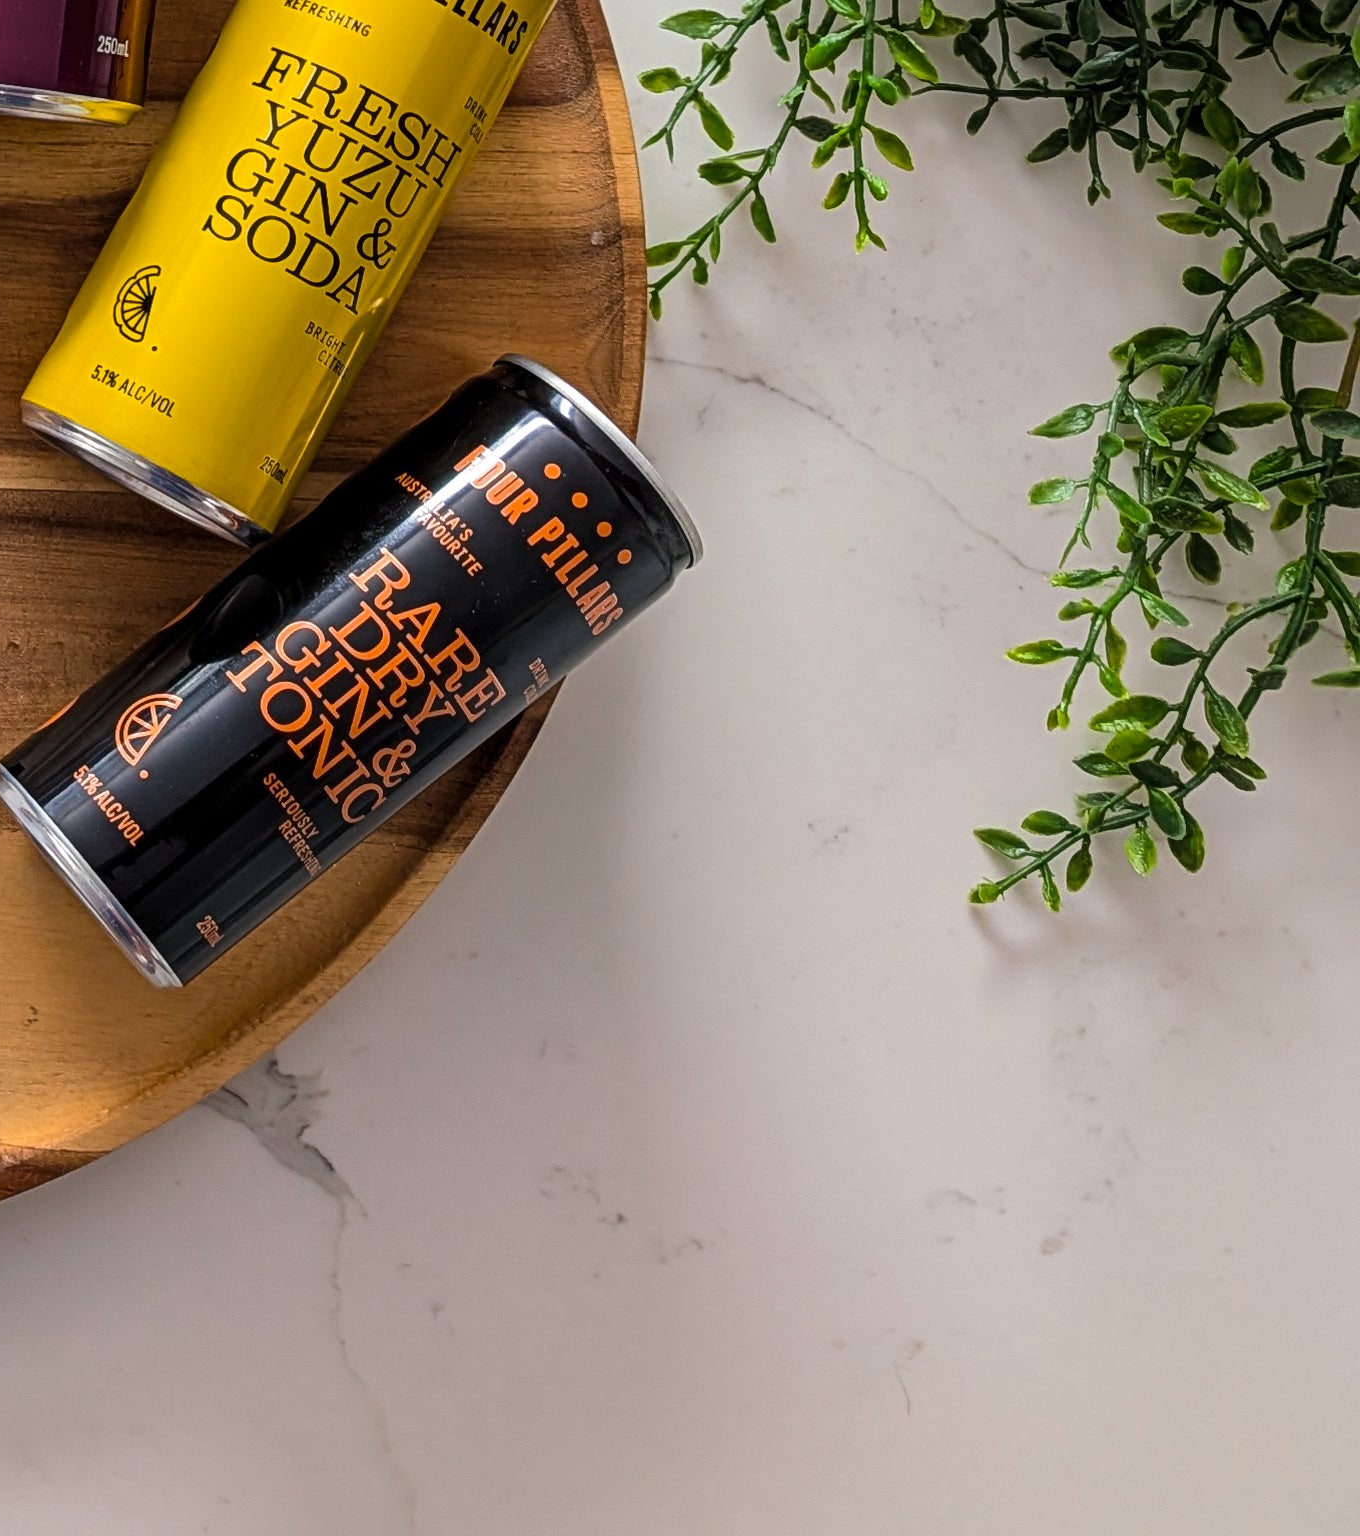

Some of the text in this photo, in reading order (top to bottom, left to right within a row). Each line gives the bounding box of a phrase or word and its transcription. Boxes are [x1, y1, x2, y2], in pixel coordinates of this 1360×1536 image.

[252, 46, 462, 188] FRESH
[256, 99, 428, 219] YUZU
[201, 194, 366, 316] SODA
[226, 148, 397, 270] GIN &
[91, 365, 176, 418] 5.1% ALC/VOL
[305, 320, 346, 355] BRIGHT
[395, 472, 474, 542] AUSTRLIA'S
[452, 444, 624, 636] FOUR PILLARS
[328, 600, 456, 736] DRY
[348, 547, 506, 723] RARE
[226, 640, 388, 825] TONIC
[274, 620, 417, 788] GIN &
[73, 764, 145, 847] 5.1% ALC/VOL
[263, 772, 320, 839] SERIOUSLY
